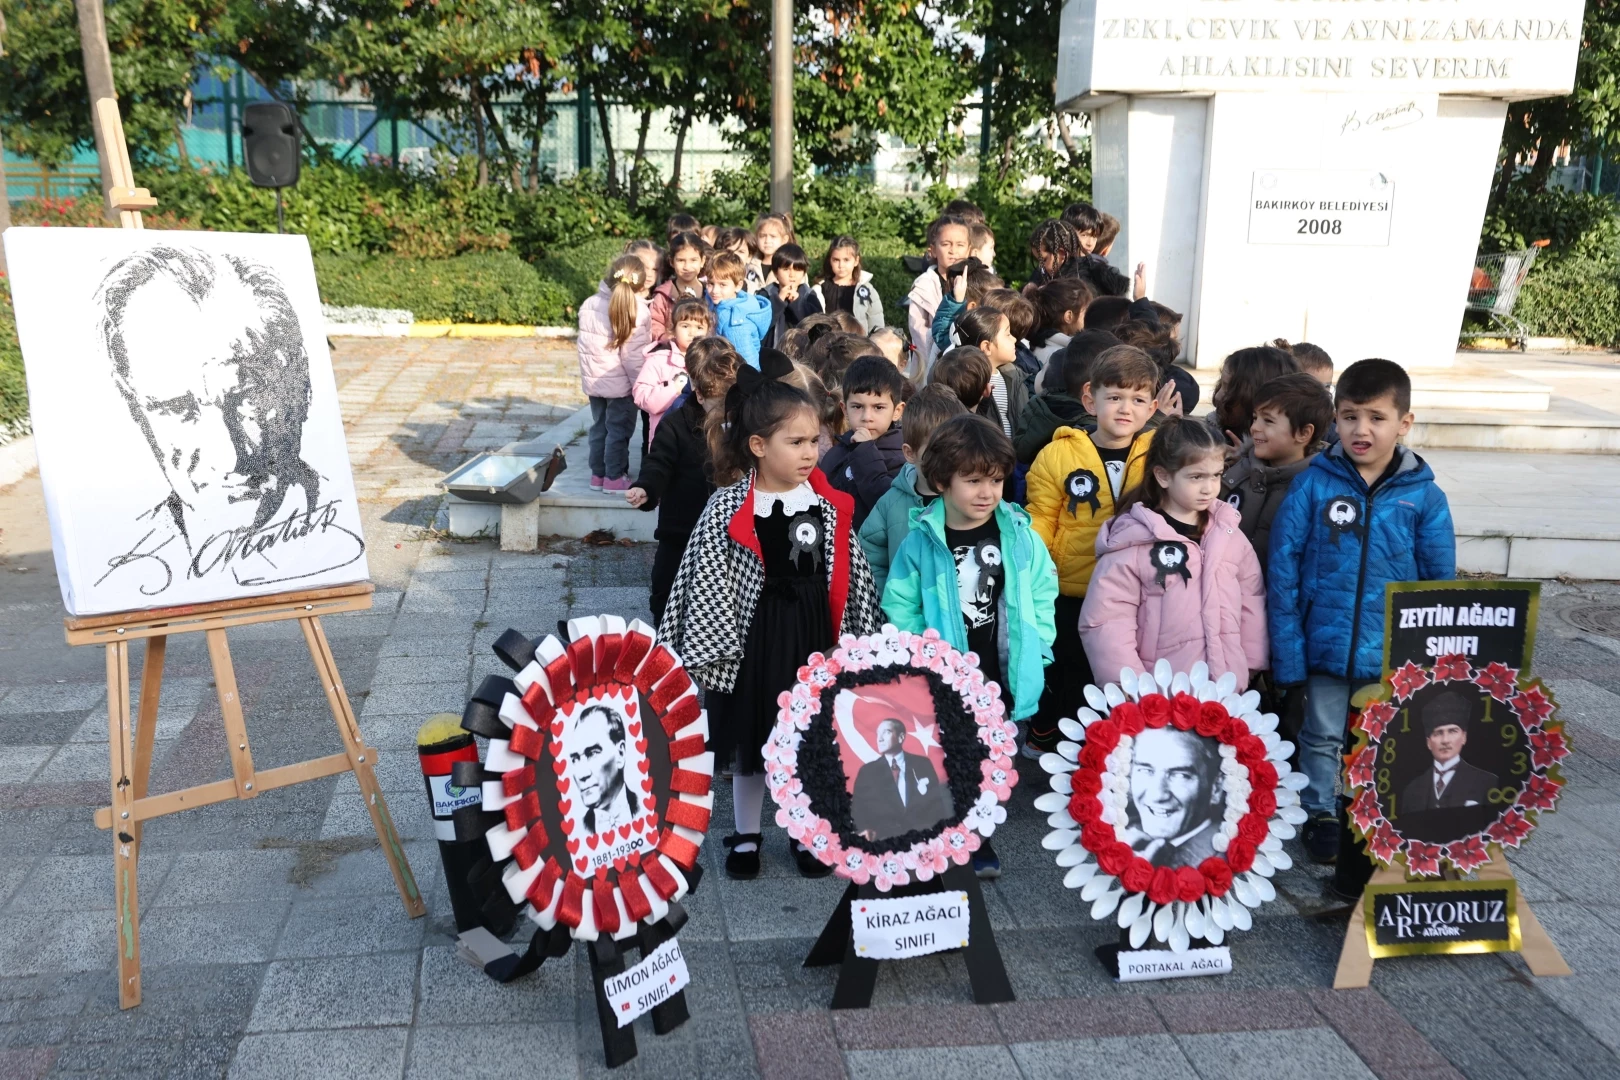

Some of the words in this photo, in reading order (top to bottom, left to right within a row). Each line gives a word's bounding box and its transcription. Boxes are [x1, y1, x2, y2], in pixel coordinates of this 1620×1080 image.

[1294, 18, 1332, 41] VE
[1371, 56, 1513, 79] SEVERIM
[1255, 199, 1315, 210] BAKIRKÖY
[1319, 200, 1388, 212] BELEDİYESİ
[1297, 218, 1342, 235] 2008
[1399, 603, 1454, 629] ZEYTİN
[1456, 602, 1516, 628] AĞACI
[1425, 636, 1478, 657] SINIFI
[866, 912, 910, 929] KİRAZ
[914, 905, 961, 923] AĞACI
[895, 932, 935, 951] SINIFI
[606, 966, 650, 998] LİMON
[651, 946, 682, 976] AĞACI
[1128, 962, 1186, 974] PORTAKAL
[1190, 958, 1223, 970] AĞACI
[637, 982, 670, 1011] SINIFI
